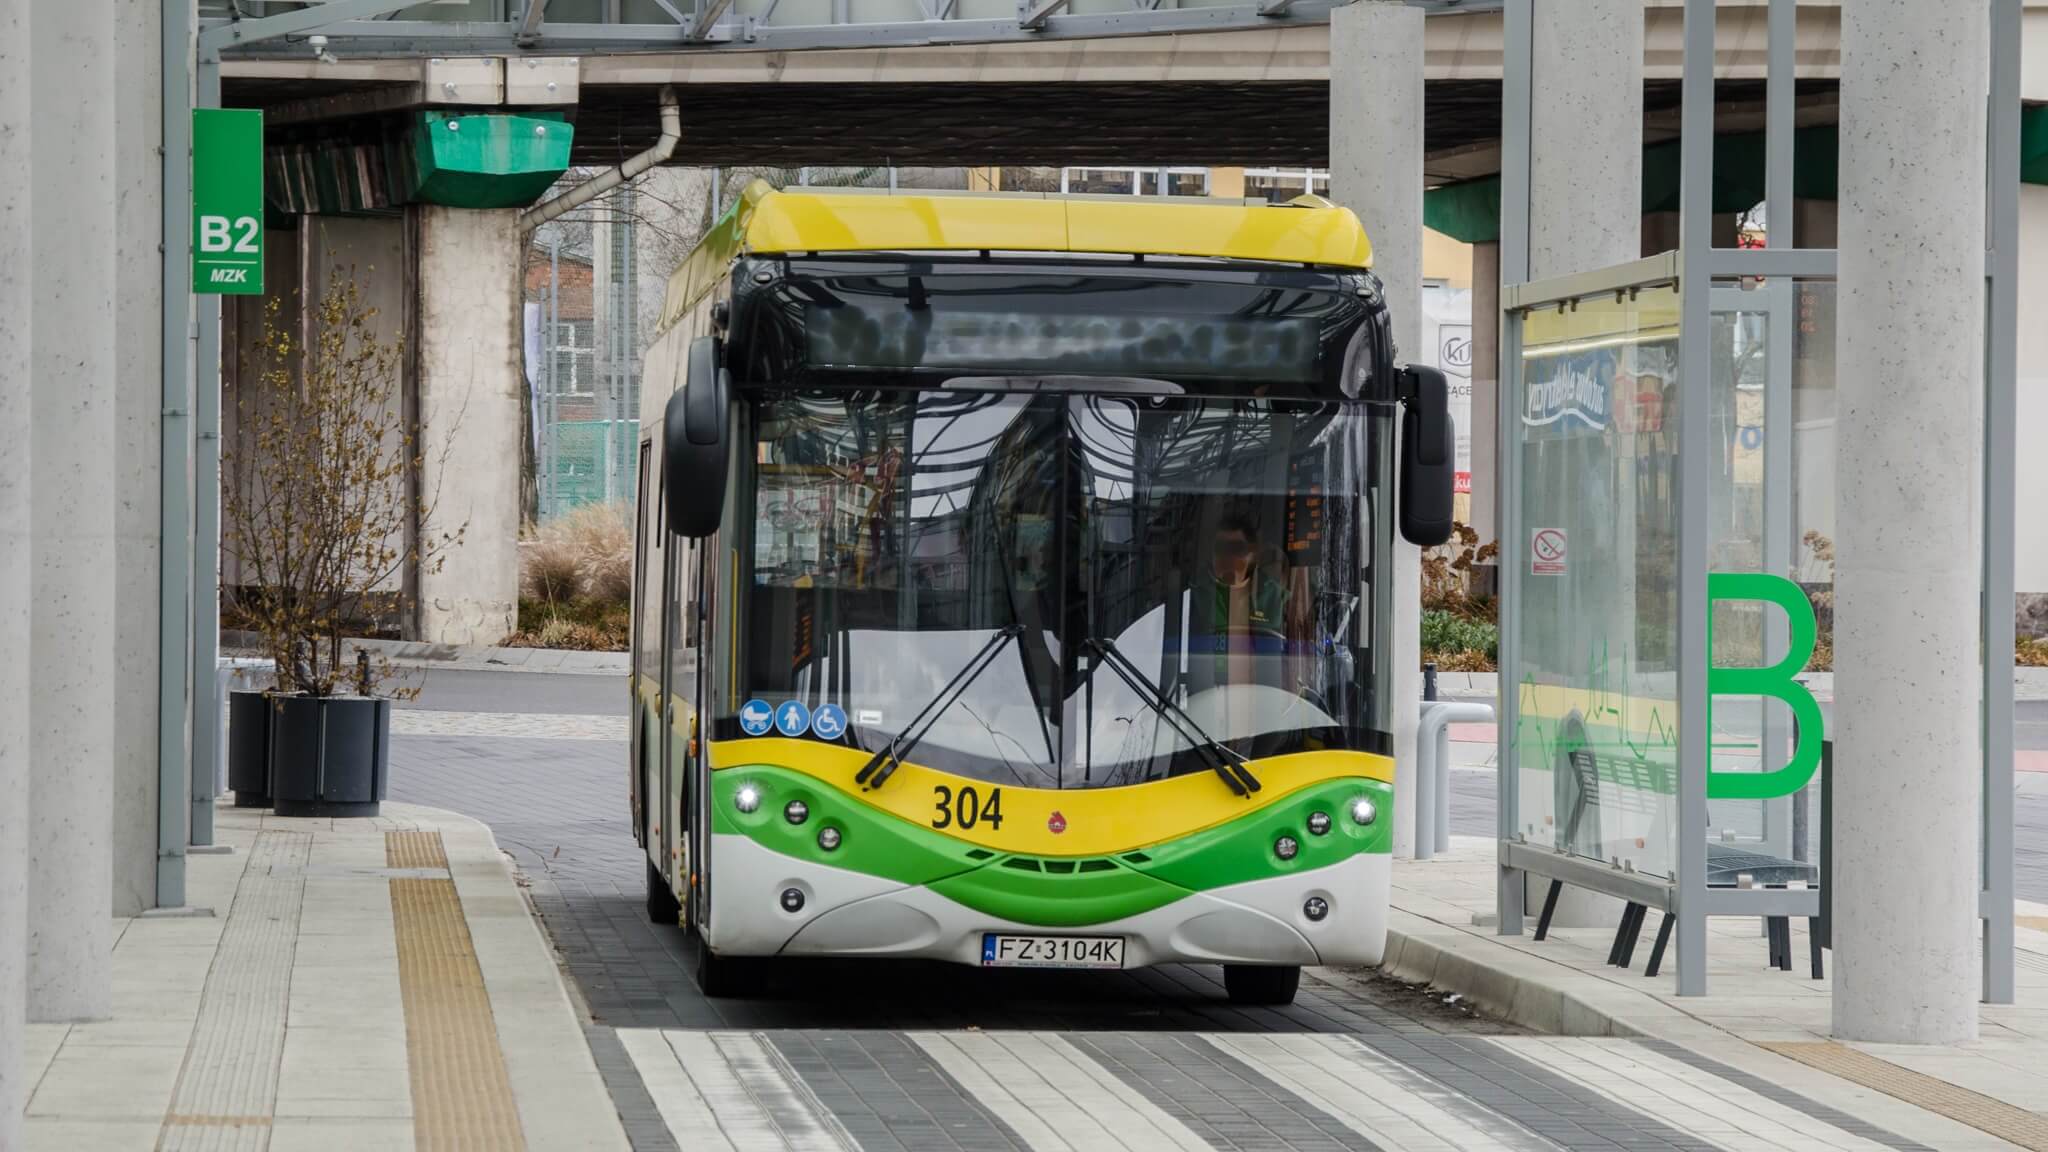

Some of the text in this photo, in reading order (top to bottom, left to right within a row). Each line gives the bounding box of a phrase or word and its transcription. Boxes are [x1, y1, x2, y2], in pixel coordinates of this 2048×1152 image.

[200, 215, 259, 253] B2
[210, 268, 248, 283] MZK
[1706, 572, 1824, 800] B
[932, 785, 1003, 830] 304
[999, 938, 1118, 962] FZ 3104K
